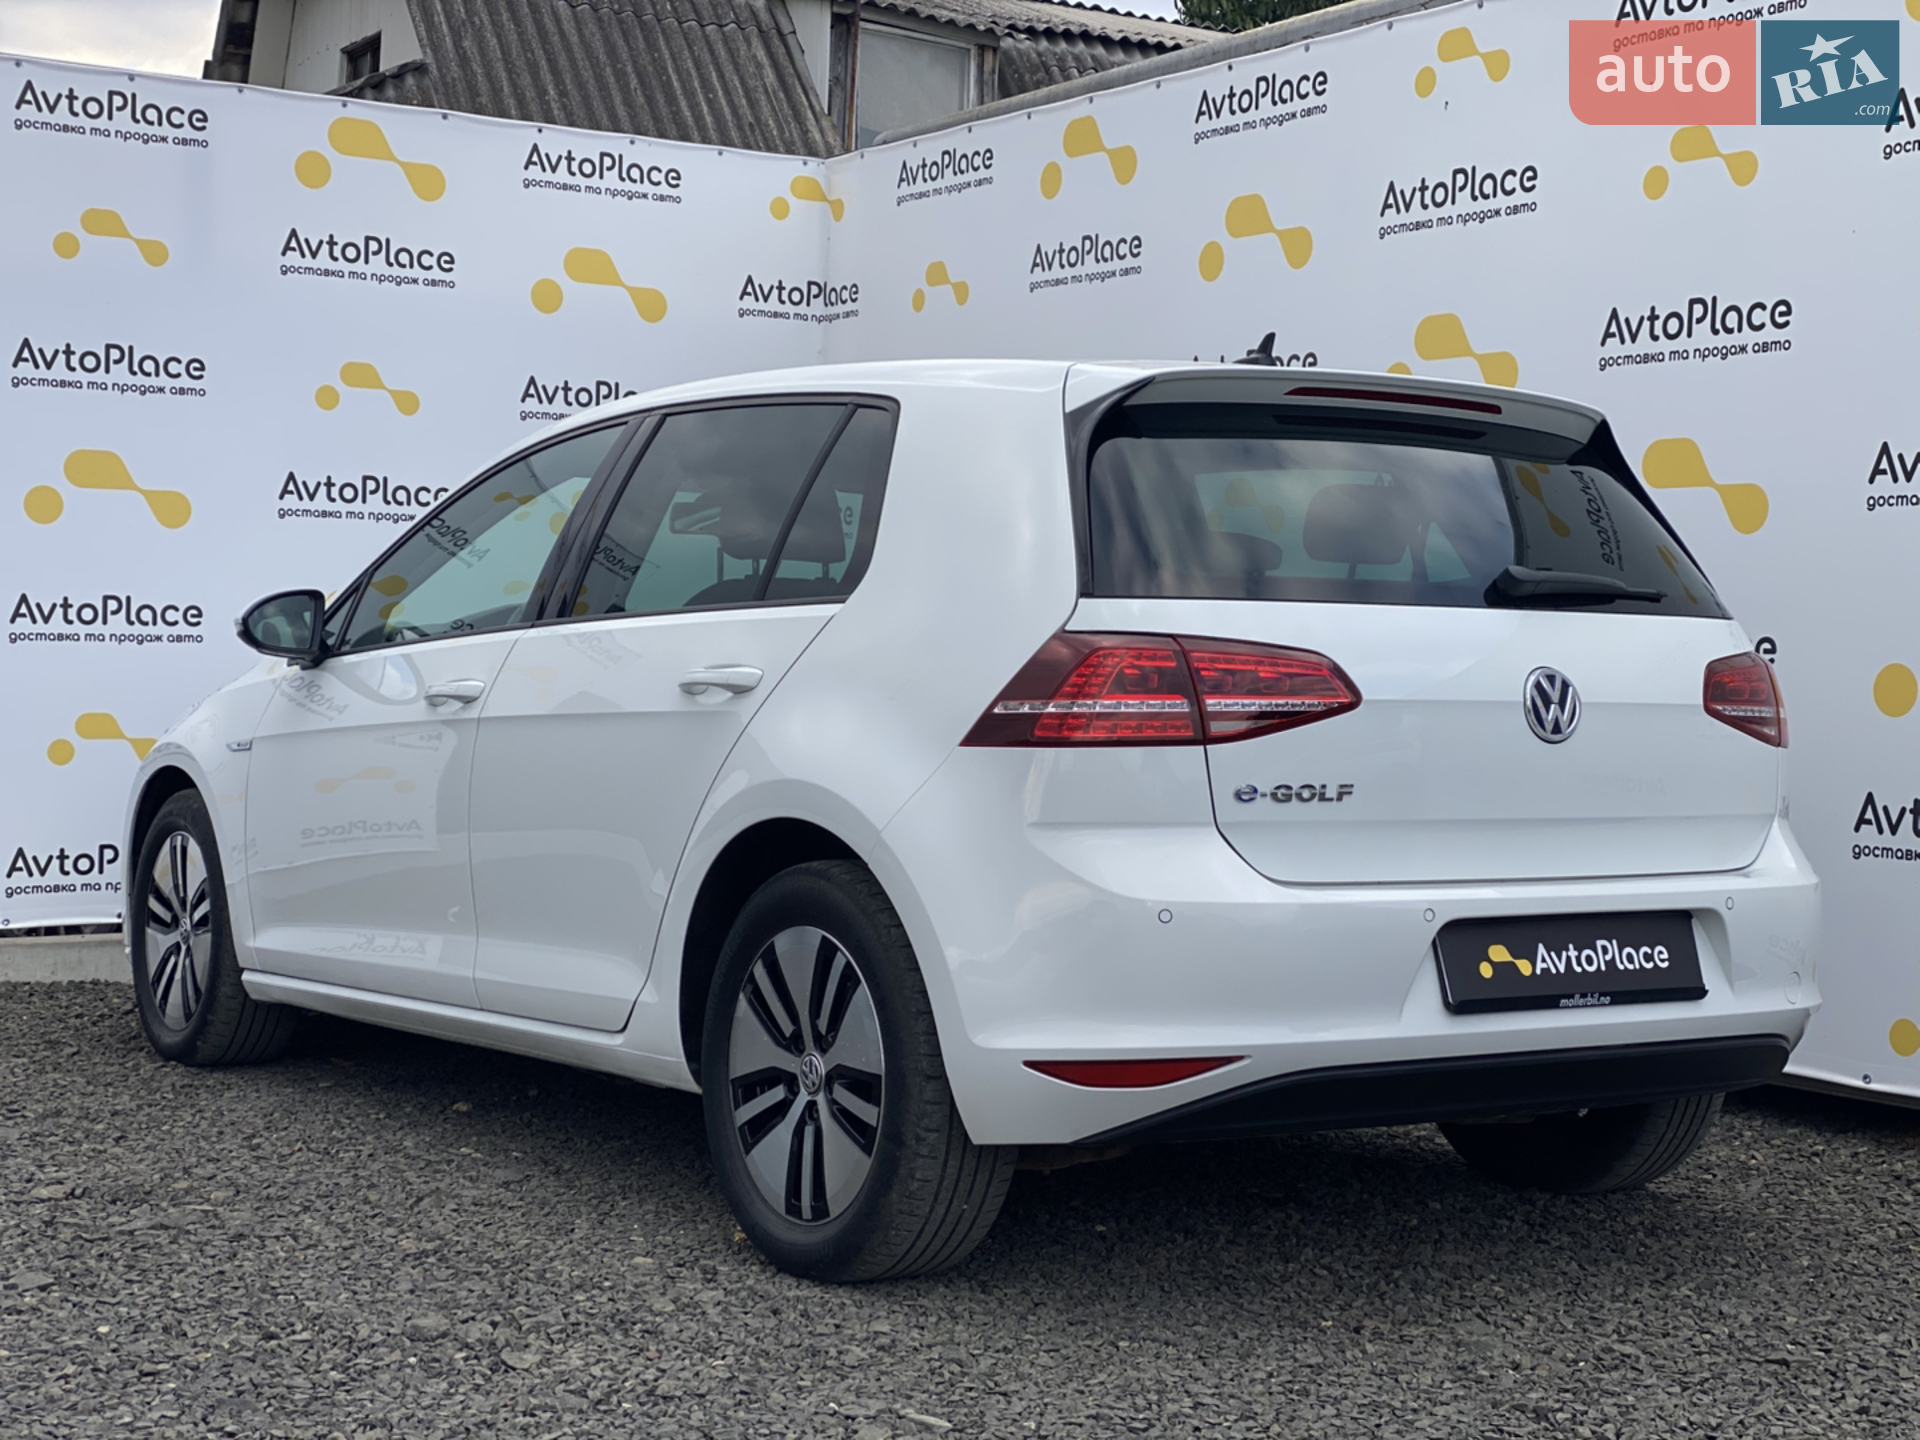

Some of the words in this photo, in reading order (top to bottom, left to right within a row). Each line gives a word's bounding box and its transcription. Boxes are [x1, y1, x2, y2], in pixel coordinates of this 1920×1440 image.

[15, 80, 208, 131] AvtoPlace
[1195, 71, 1328, 124] AvtoPlace
[524, 143, 681, 188] AvtoPlace
[897, 148, 993, 189] AvtoPlace
[1380, 165, 1538, 217] AvtoPlace
[281, 228, 455, 273] AvtoPlace
[1030, 233, 1142, 274] AvtoPlace
[739, 275, 859, 308] AvtoPlace
[1600, 296, 1792, 347] AvtoPlace
[12, 337, 206, 380] AvtoPlace
[520, 375, 637, 408] AvtoPl
[9, 593, 203, 627] AvtoPlace
[1233, 784, 1354, 804] e-GOLF
[6, 844, 120, 879] AvtoP
[1535, 938, 1670, 976] AvtoPlace
